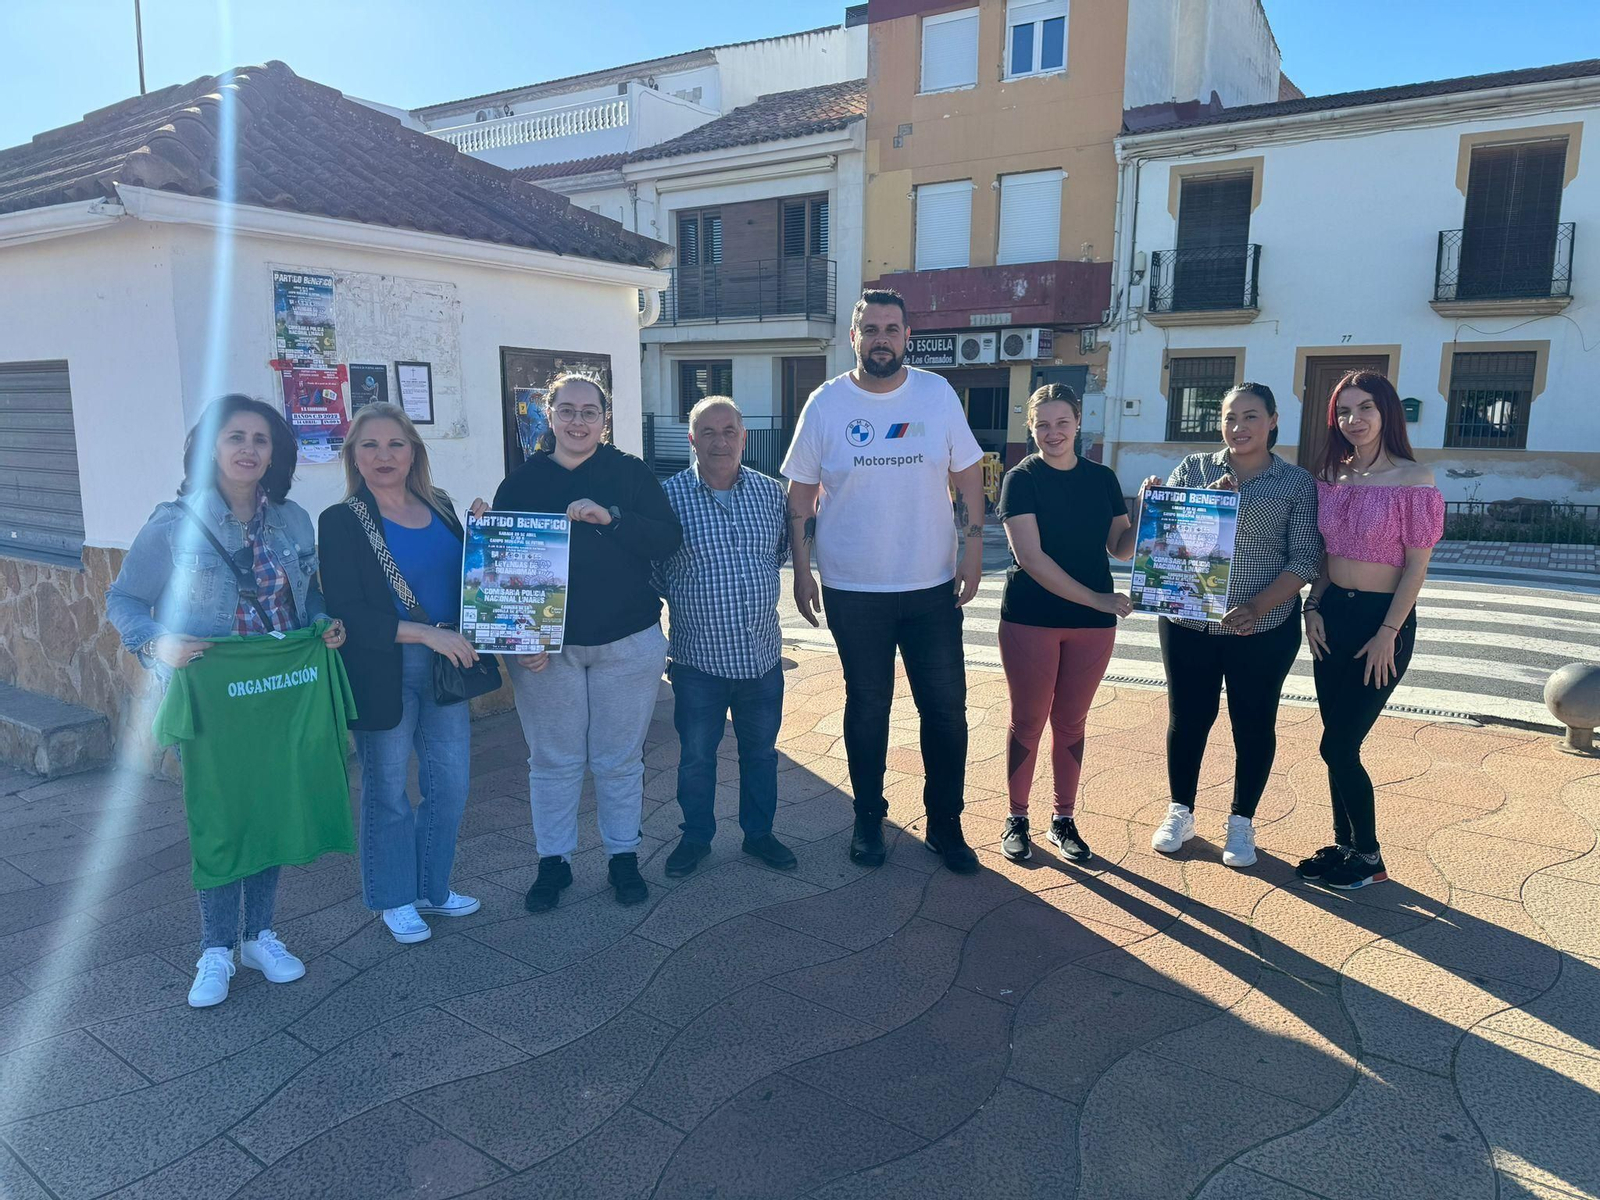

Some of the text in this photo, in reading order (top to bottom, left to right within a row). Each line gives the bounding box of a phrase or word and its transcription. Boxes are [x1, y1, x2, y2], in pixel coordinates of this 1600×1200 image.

[274, 273, 302, 283] PARTIDO
[1341, 335, 1352, 343] 77
[906, 339, 953, 352] O ESCUELA
[902, 354, 953, 364] de Los Granados
[853, 453, 924, 467] Motorsport
[1145, 489, 1236, 506] PARTIDO BENEFICO
[468, 515, 567, 530] PARTIDO BENEFICO
[484, 588, 520, 596] COMISARIA
[484, 595, 545, 604] NACIONAL LINARES
[228, 664, 318, 697] ORGANIZACIÓN
